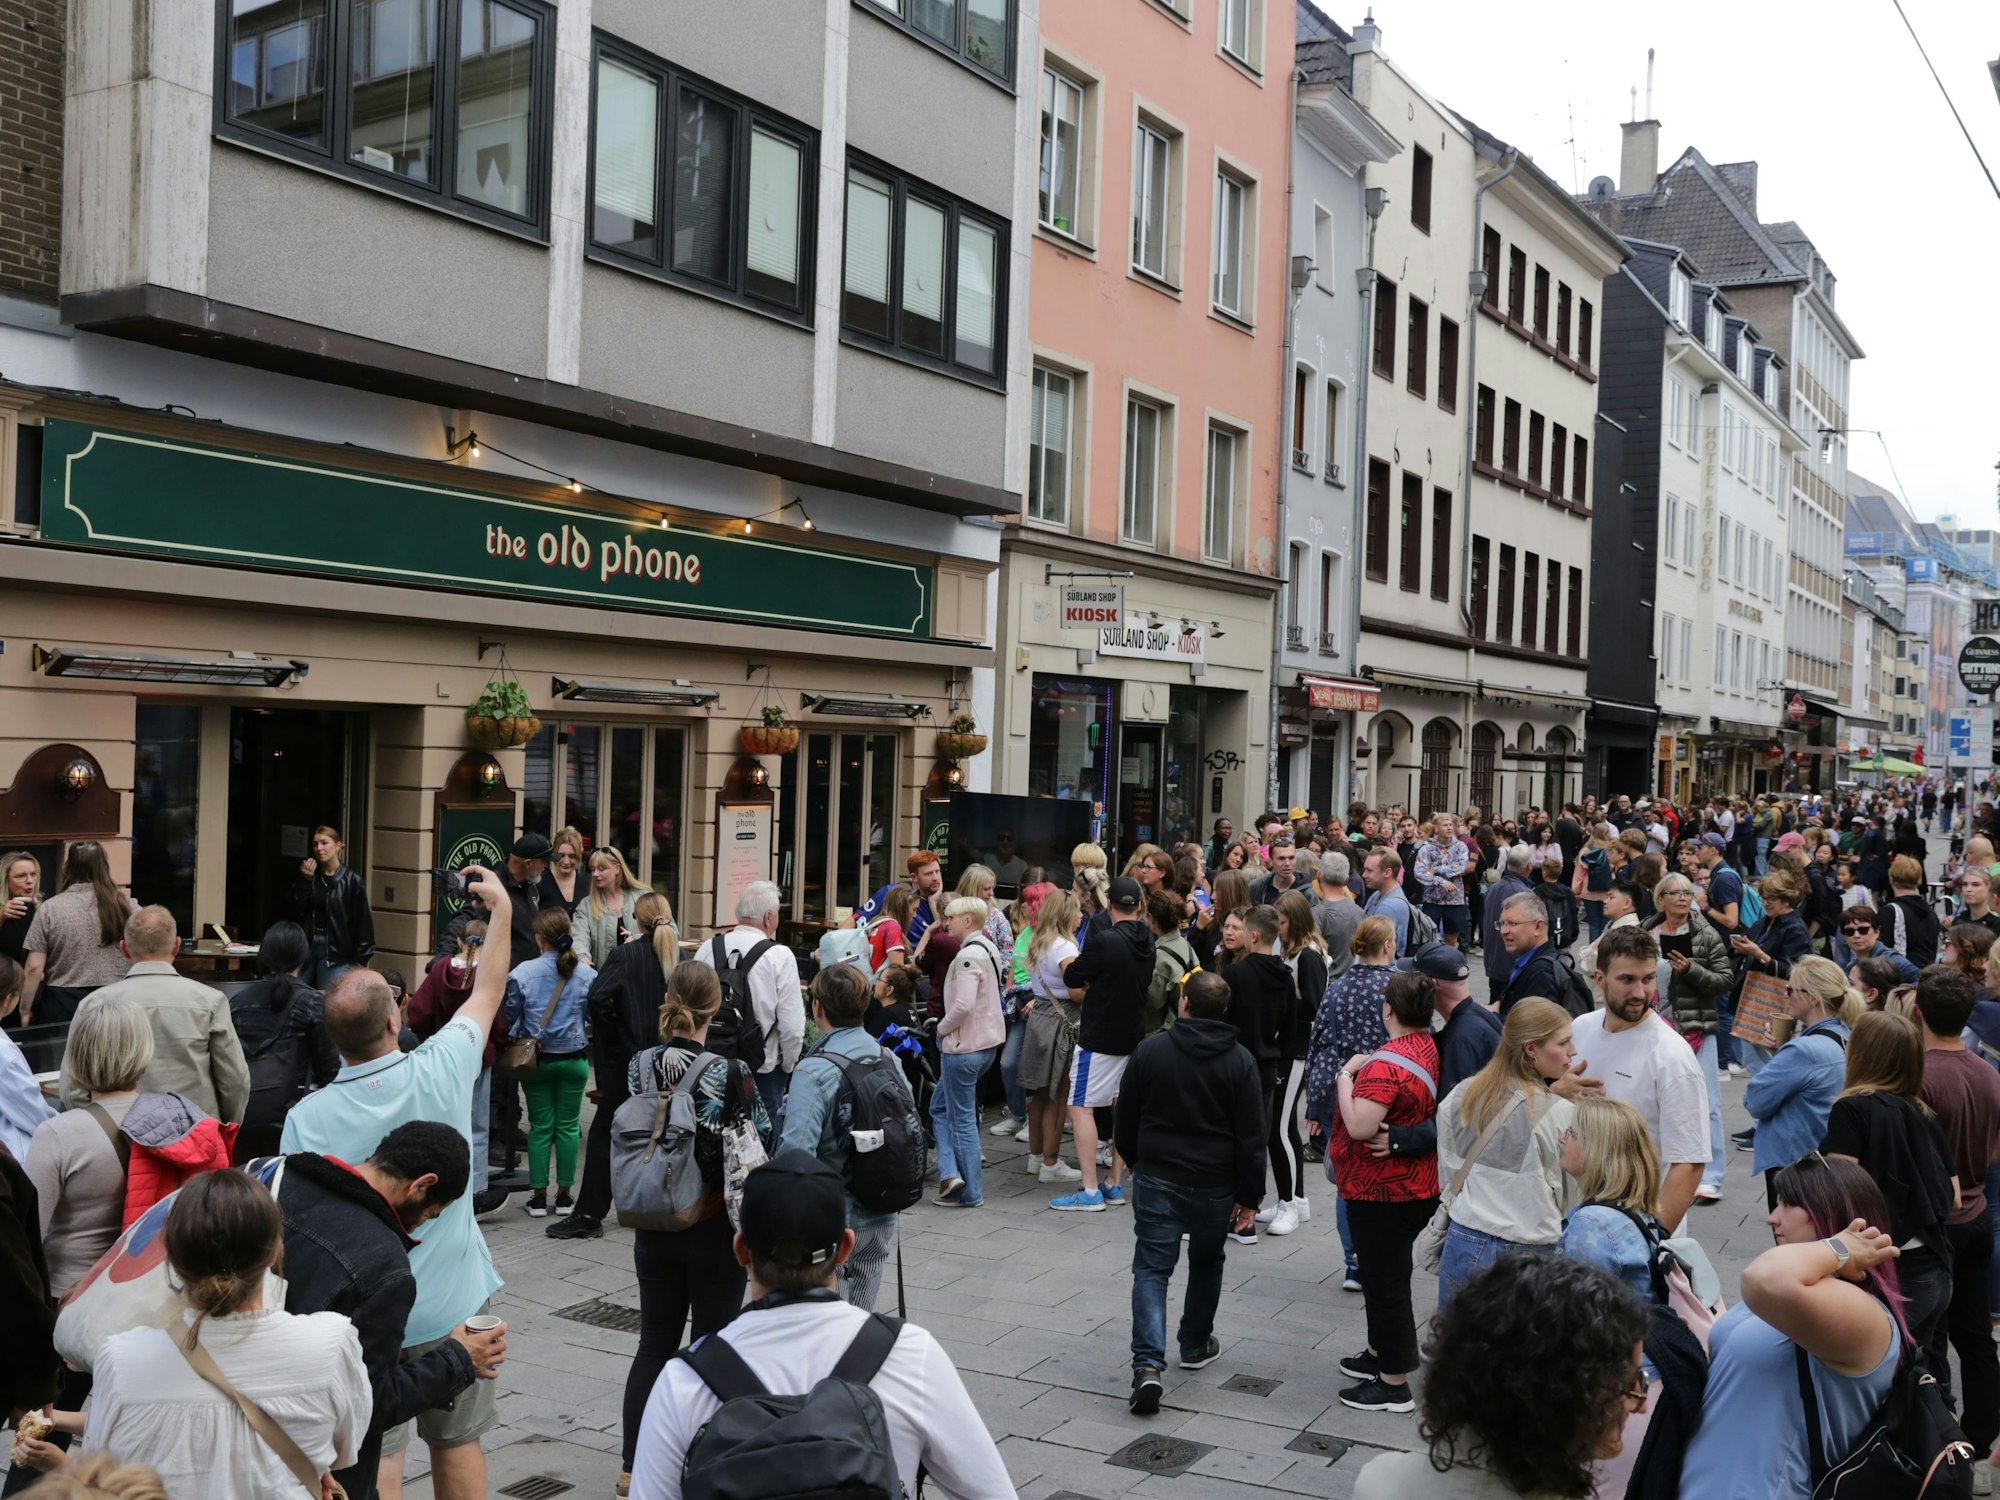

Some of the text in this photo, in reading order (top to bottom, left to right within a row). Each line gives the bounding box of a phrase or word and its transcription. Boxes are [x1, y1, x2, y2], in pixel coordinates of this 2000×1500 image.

[1703, 427, 1717, 489] HOTEL
[486, 523, 702, 585] the old phone
[1700, 531, 1713, 593] GEORG
[1098, 592, 1117, 602] SHOP
[1066, 607, 1118, 622] KIOSK
[1146, 632, 1169, 651] SHOP
[1178, 634, 1201, 654] KIOSK
[1965, 647, 2000, 656] GUINNESS
[736, 819, 756, 829] phone
[937, 826, 946, 837] OLD
[450, 842, 500, 869] THE OLD PHONE
